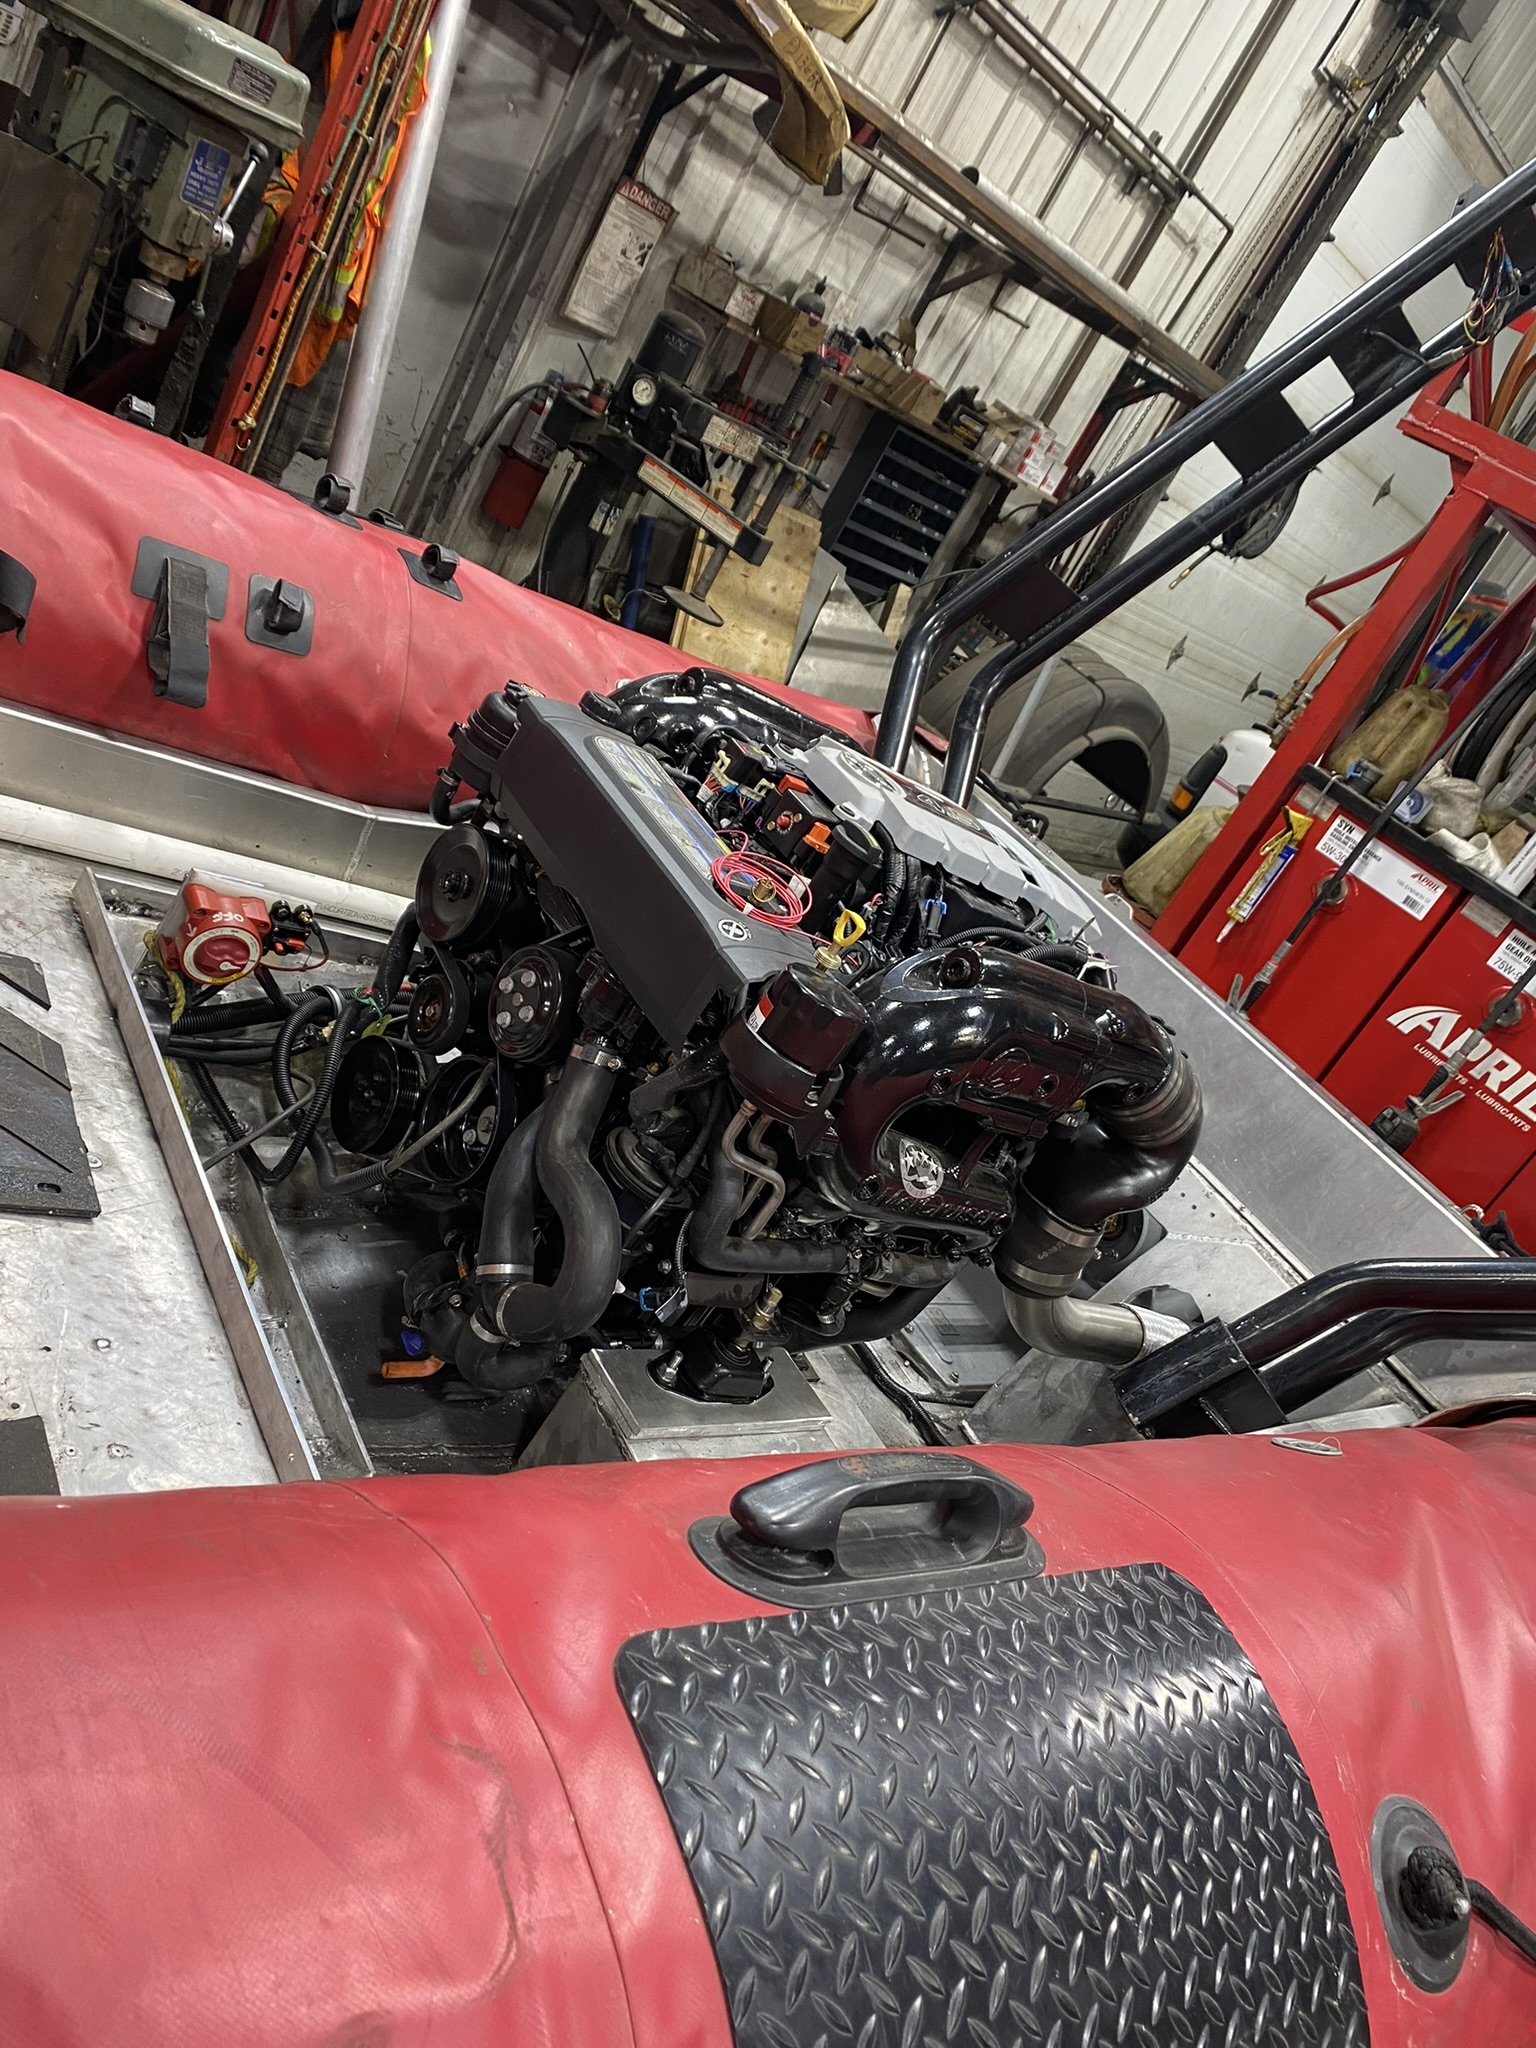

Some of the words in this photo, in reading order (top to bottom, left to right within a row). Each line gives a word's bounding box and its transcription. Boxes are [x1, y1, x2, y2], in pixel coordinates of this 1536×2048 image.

[194, 156, 225, 175] JET
[629, 185, 671, 219] DANGER
[1337, 819, 1356, 835] SYN
[1410, 872, 1440, 892] APRIL
[212, 912, 244, 922] OFF
[315, 903, 360, 920] EVACUATION
[1505, 943, 1525, 959] GEAR
[1511, 934, 1533, 952] HUILE
[1493, 956, 1523, 981] 75W-9
[1386, 1005, 1536, 1123] APRIL
[1475, 1089, 1532, 1133] LUBRICANTS
